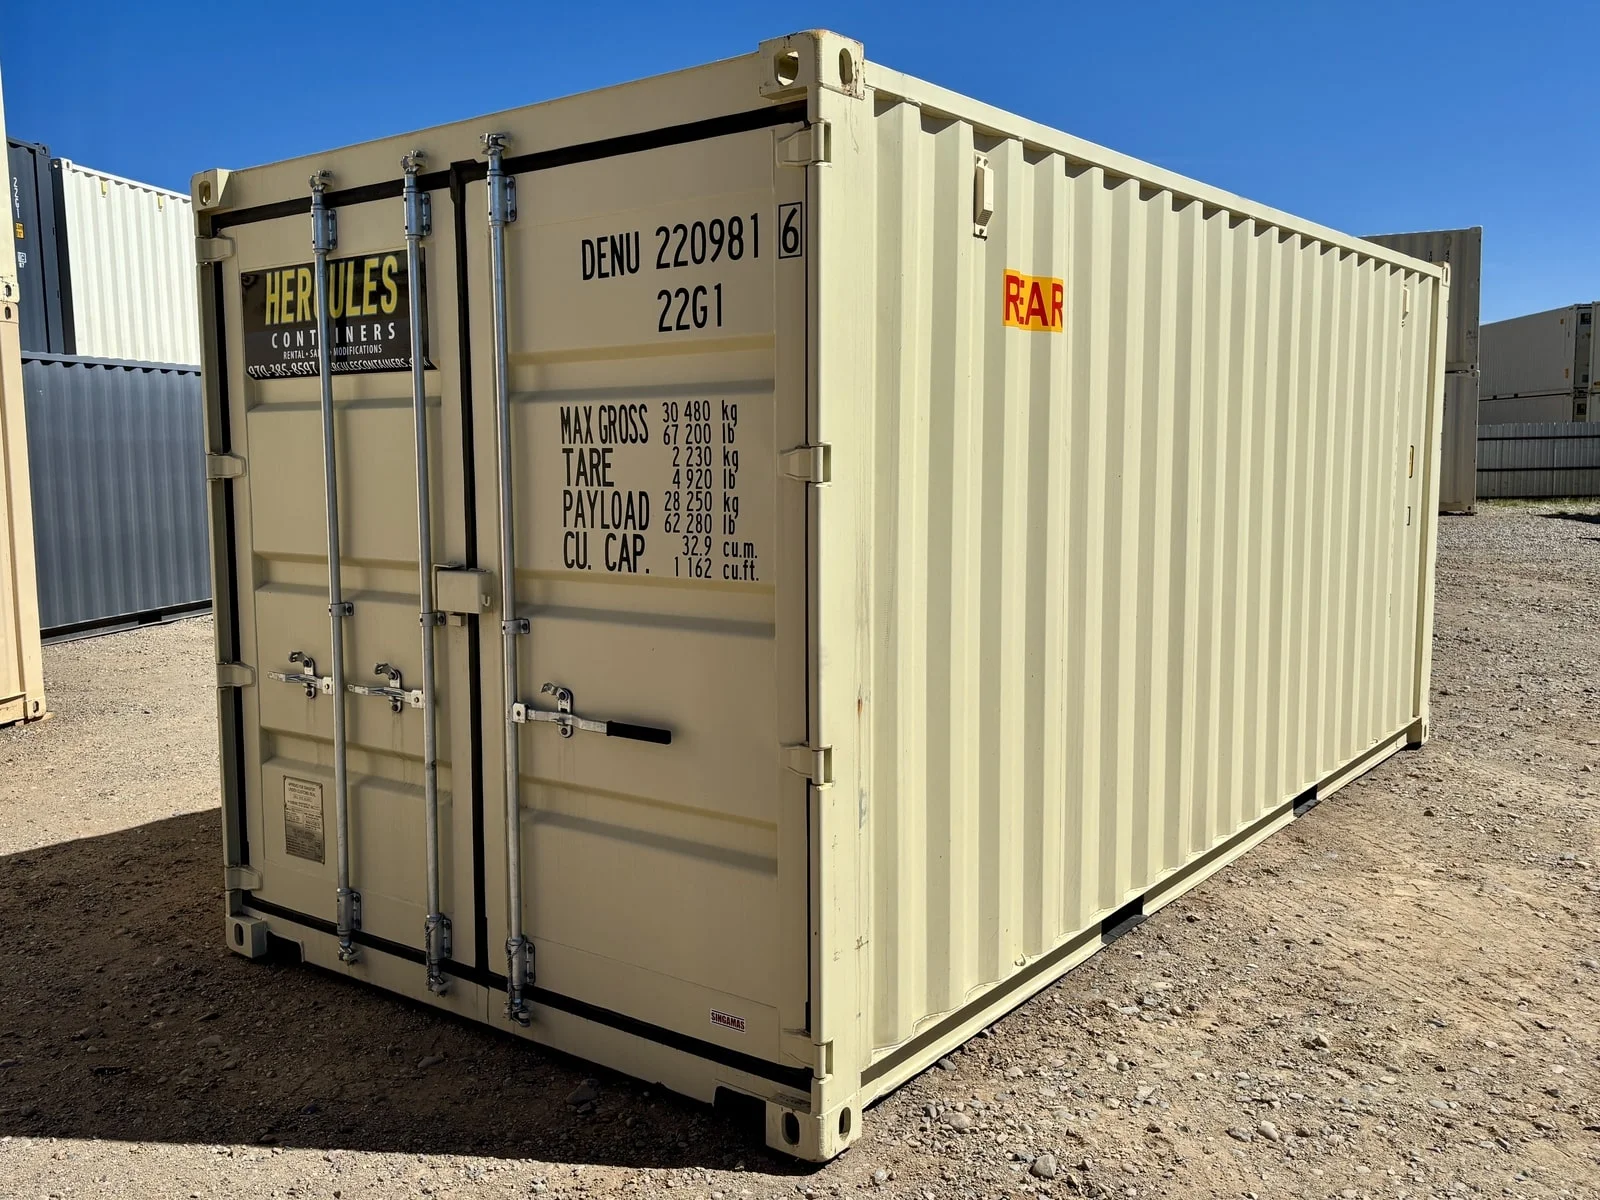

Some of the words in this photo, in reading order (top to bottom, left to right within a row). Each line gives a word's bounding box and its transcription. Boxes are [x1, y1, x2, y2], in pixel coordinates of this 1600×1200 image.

[581, 231, 640, 281] DENU
[655, 212, 759, 270] 220981
[781, 207, 800, 254] 6
[265, 255, 398, 325] HERULES
[657, 282, 722, 333] 22G1
[271, 322, 396, 349] CONTINERS
[283, 349, 305, 360] RENTAL
[333, 344, 383, 356] MODIFICATIONS
[248, 361, 318, 378] 970-385-8597
[560, 405, 594, 445] MAX
[599, 403, 649, 445] GROSS
[662, 401, 679, 423] 30
[684, 400, 711, 422] 480
[721, 399, 738, 427] kg
[663, 424, 679, 445] 67
[685, 423, 711, 445] 200
[722, 422, 735, 444] lb
[562, 447, 615, 487] TARE
[672, 446, 680, 467] 2
[686, 445, 712, 467] 230
[723, 445, 739, 473] kg
[672, 468, 681, 490] 4
[686, 468, 712, 490] 920
[723, 469, 736, 490] lb
[563, 489, 650, 531] PAYLOAD
[664, 491, 680, 512] 28
[686, 490, 712, 512] 250
[723, 491, 739, 519] kg
[664, 513, 681, 534] 62
[686, 512, 712, 534] 280
[723, 514, 736, 535] lb
[563, 531, 592, 570] CU.
[604, 532, 650, 574] CAP.
[682, 535, 712, 556] 32.9
[722, 541, 758, 559] cu.m.
[674, 556, 679, 577] 1
[687, 557, 712, 579] 162
[722, 559, 759, 582] cu.ft.
[711, 1011, 745, 1030] SINGAMAS
